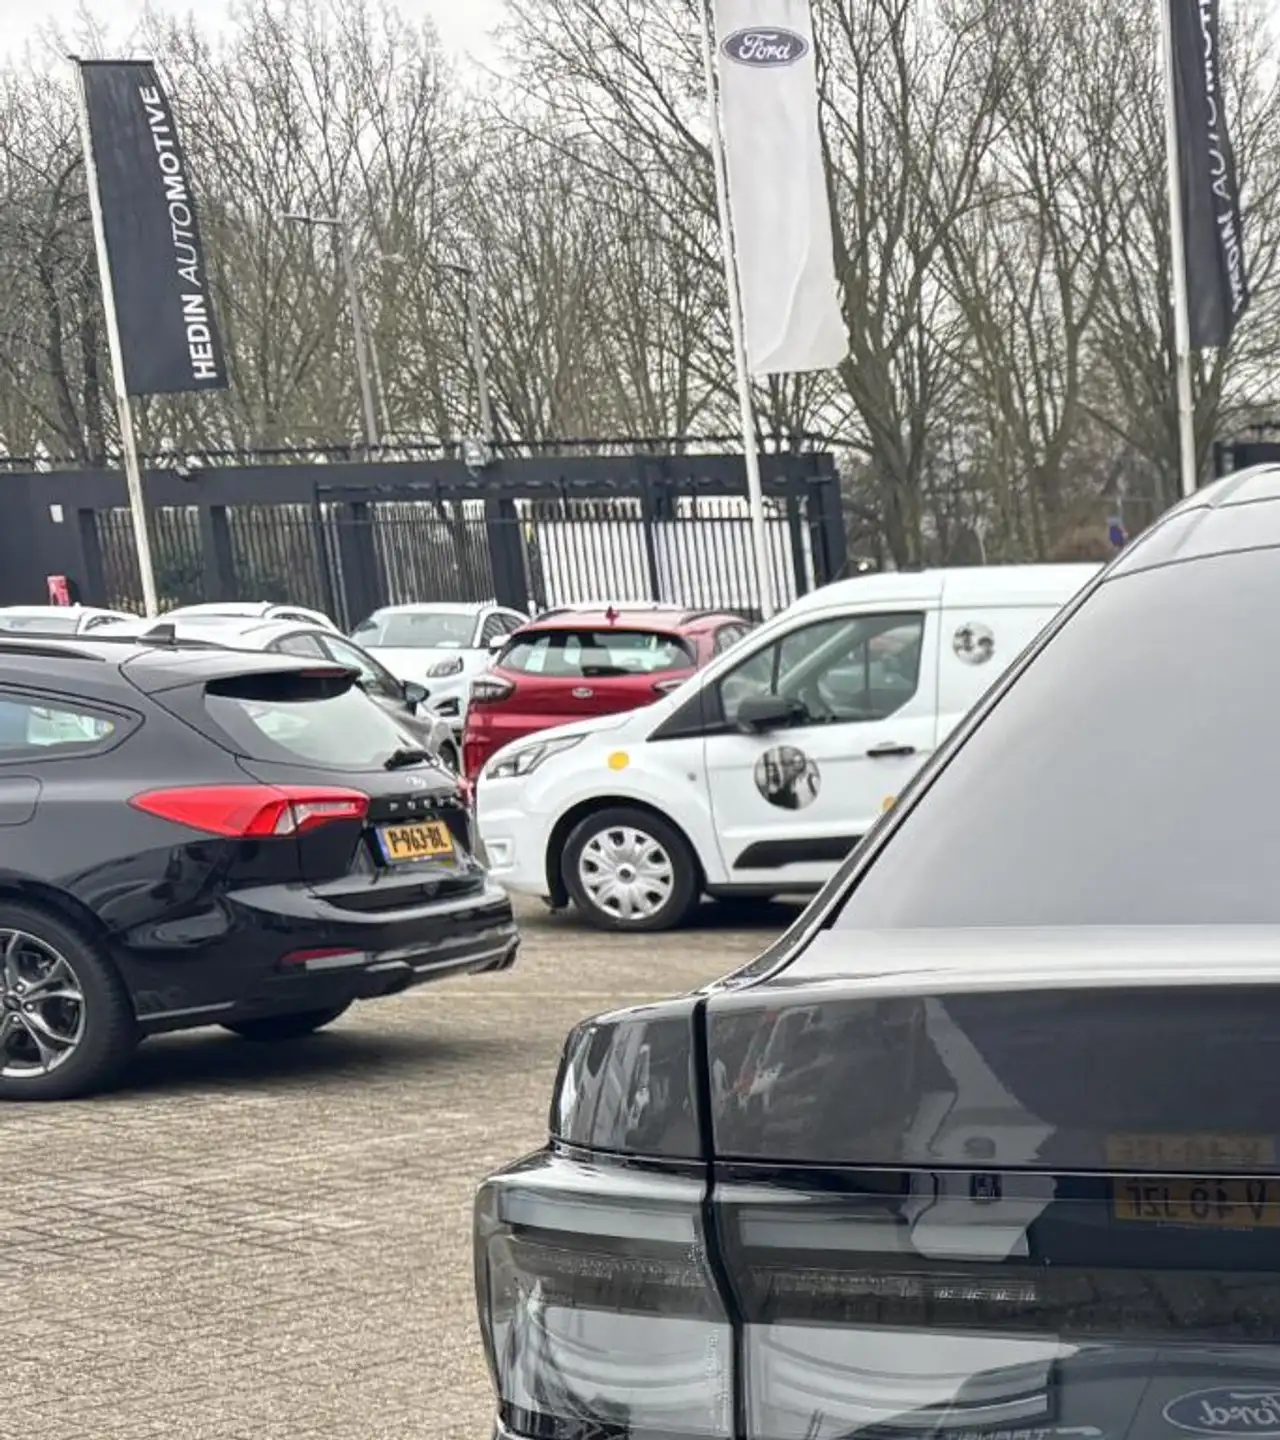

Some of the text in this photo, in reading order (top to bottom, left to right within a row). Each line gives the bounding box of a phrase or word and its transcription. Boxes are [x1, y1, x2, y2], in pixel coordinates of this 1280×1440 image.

[739, 33, 791, 60] Ford
[139, 85, 217, 380] HEDIN AUTOMOTIVE
